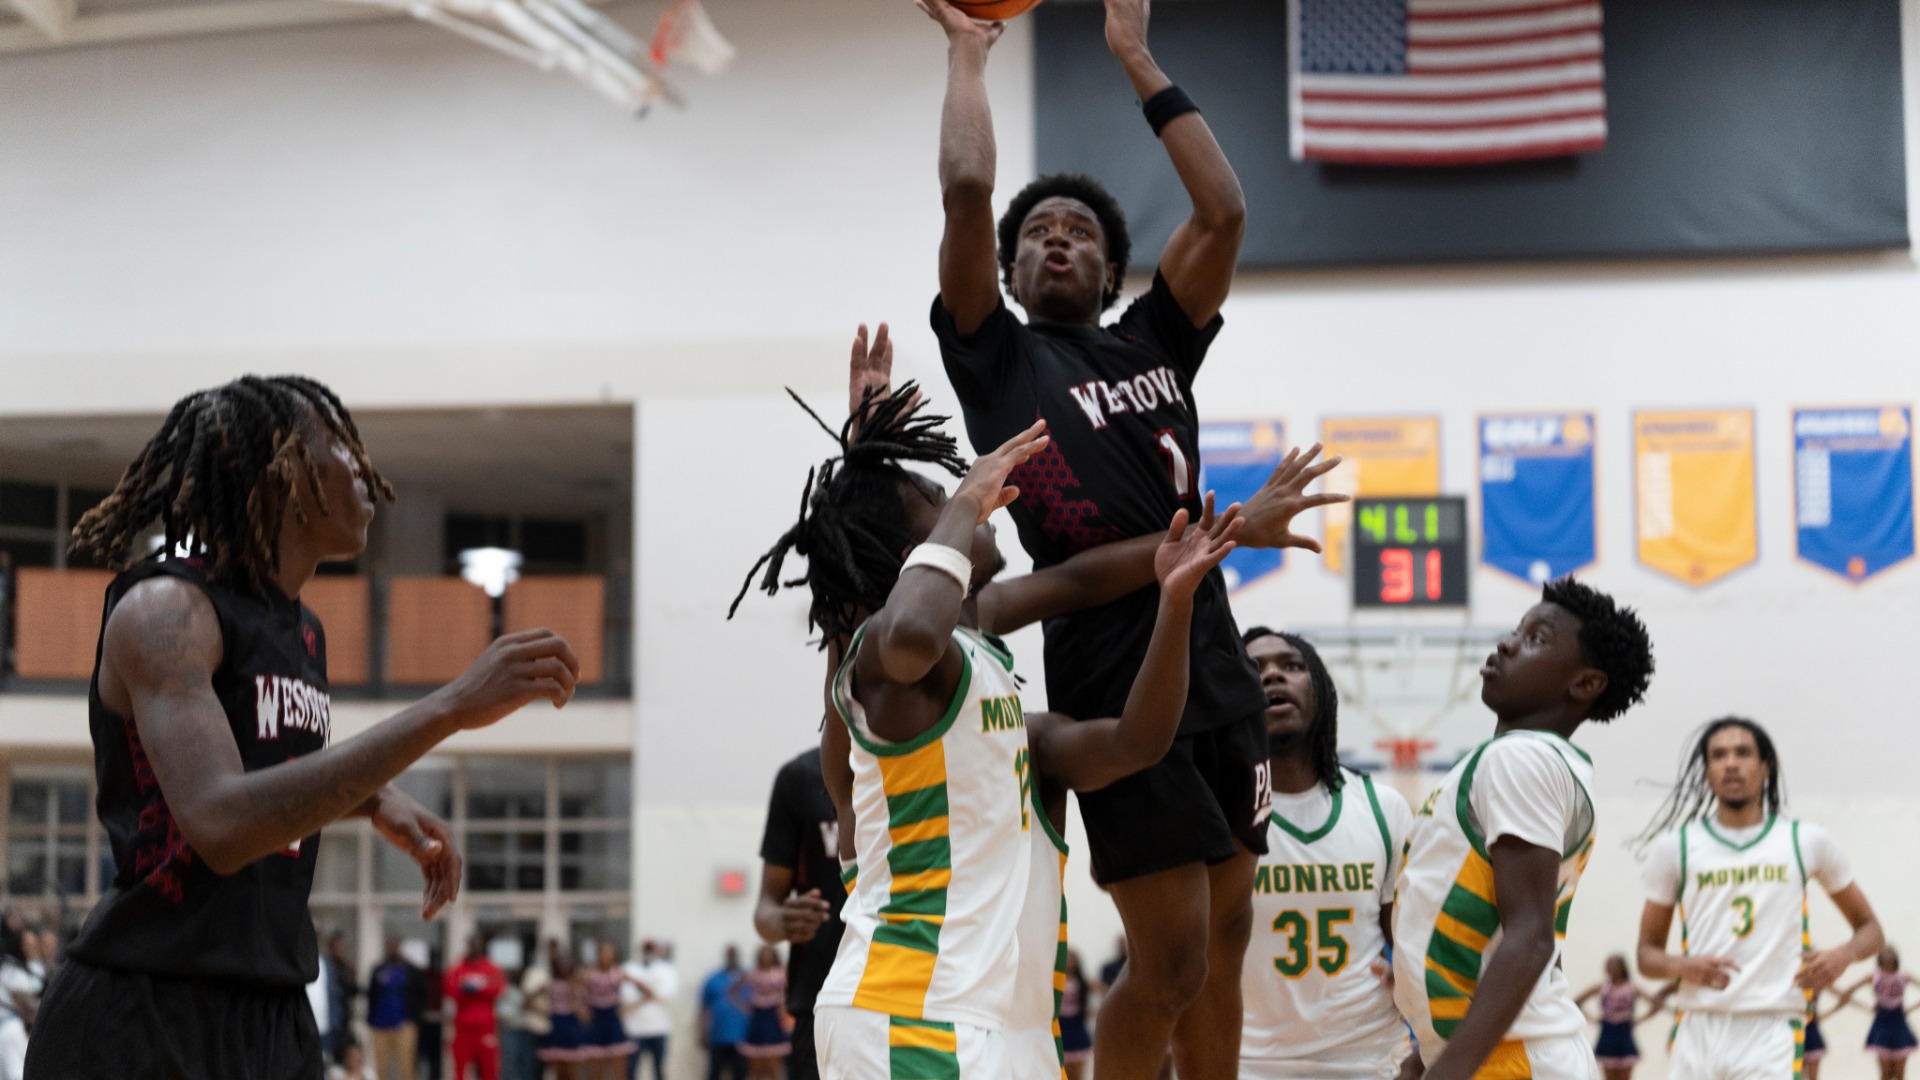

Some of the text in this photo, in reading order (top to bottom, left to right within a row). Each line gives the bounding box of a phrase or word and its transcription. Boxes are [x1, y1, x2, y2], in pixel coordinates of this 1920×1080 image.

[1154, 428, 1194, 500] 1
[1380, 548, 1442, 603] 31
[1254, 862, 1375, 894] MONROE
[1696, 863, 1788, 889] MONROE
[1730, 894, 1755, 940] 3
[1272, 907, 1354, 980] 35
